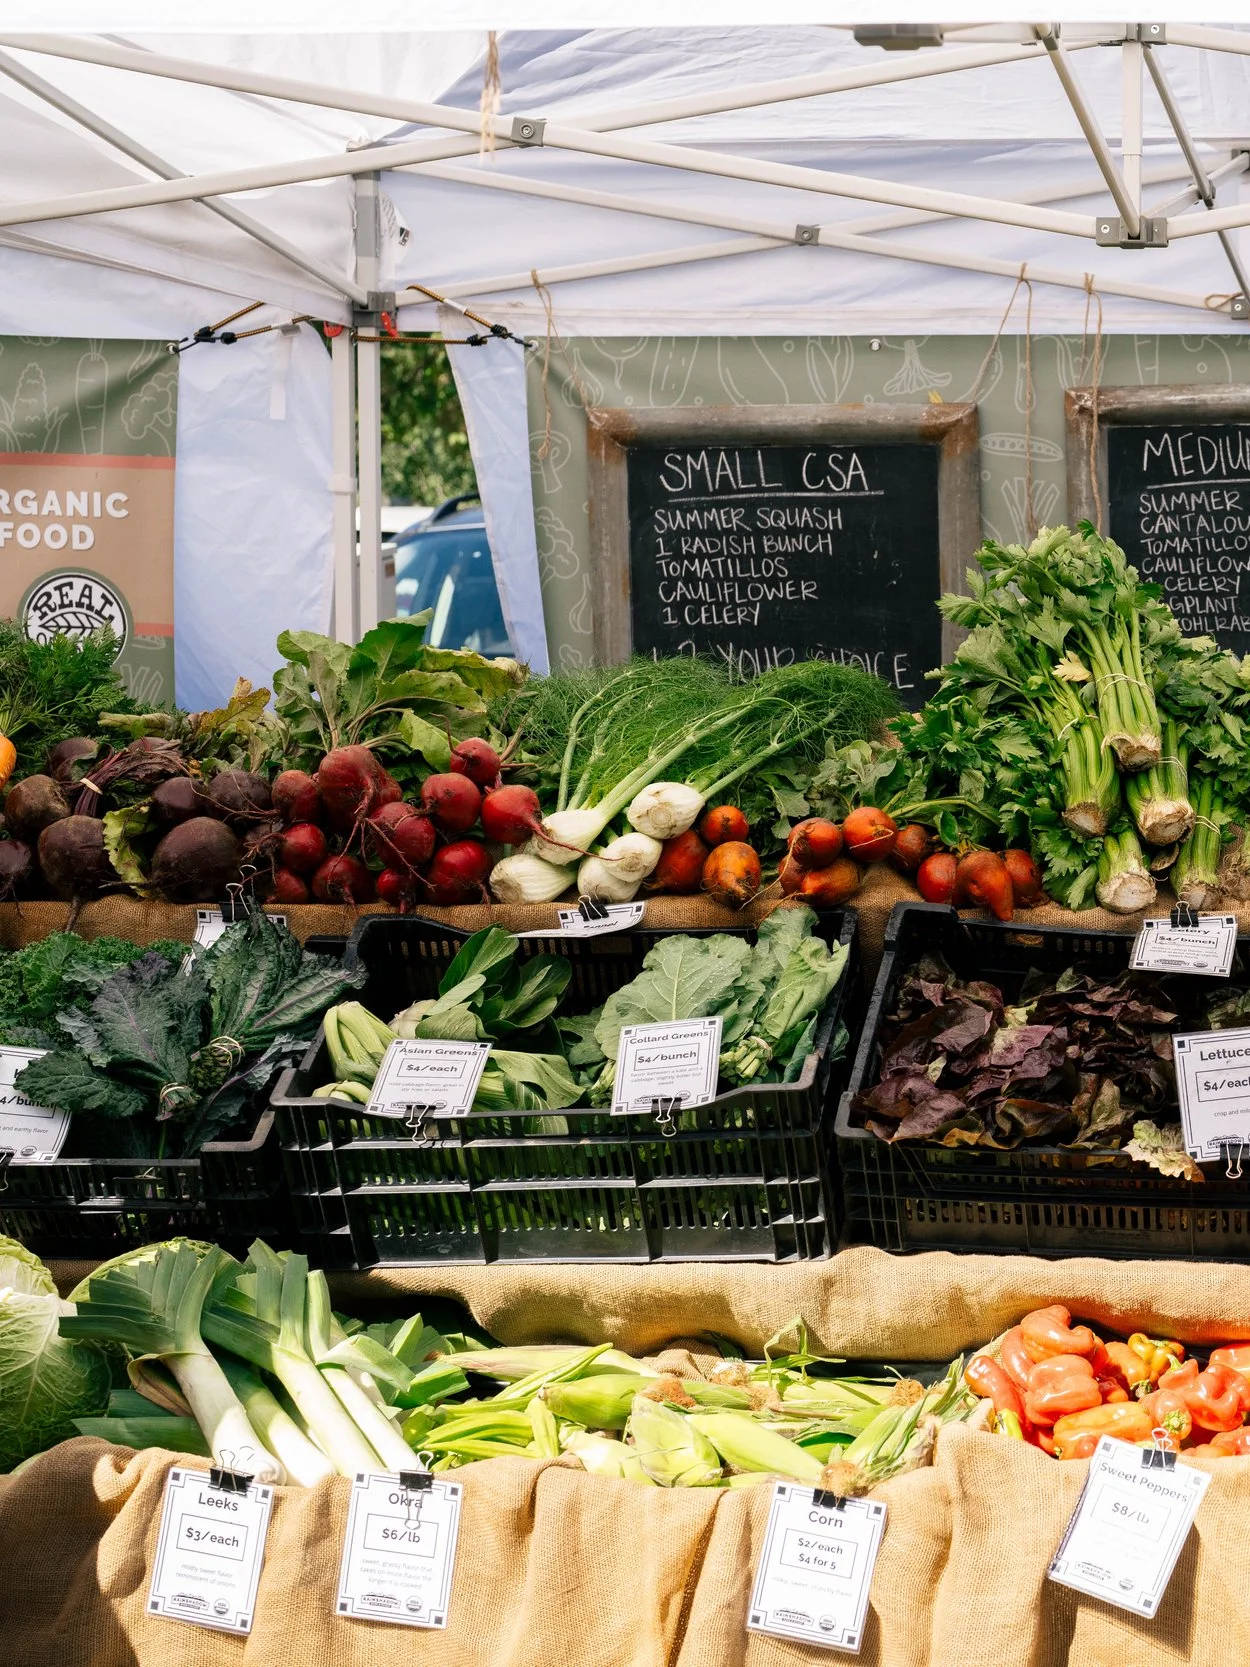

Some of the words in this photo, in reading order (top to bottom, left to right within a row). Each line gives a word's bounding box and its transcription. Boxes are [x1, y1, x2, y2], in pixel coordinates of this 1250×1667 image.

[660, 450, 783, 492] SMALL
[802, 452, 869, 491] CSA
[1140, 490, 1243, 514] SUMMER
[654, 506, 752, 534] SUMMER
[756, 506, 843, 531] SQUASH
[0, 521, 95, 551] FOOD
[656, 537, 673, 557] 1
[681, 535, 756, 556] RADISH
[763, 533, 833, 556] BUNCH
[658, 580, 819, 602] CAULIFLOWER
[1164, 575, 1241, 595] CELERY
[32, 581, 115, 622] REAL
[1158, 595, 1239, 614] GPLANT
[662, 606, 679, 625] 1
[684, 602, 760, 626] CELERY
[629, 1033, 669, 1045] Collard
[671, 1029, 709, 1040] Greens
[399, 1046, 433, 1056] Asian
[434, 1048, 479, 1057] Greens
[637, 1050, 697, 1064] $4/bunch
[406, 1064, 458, 1073] $4/each
[14, 1126, 32, 1134] earthy
[1098, 1461, 1137, 1485] Sweet
[1139, 1476, 1189, 1504] Peppers
[197, 1491, 239, 1512] Leeks
[388, 1492, 423, 1509] Okra
[808, 1510, 844, 1529] Corn
[1111, 1501, 1150, 1525] $8/lb
[185, 1526, 240, 1548] $3/each
[381, 1527, 421, 1544] $6/lb
[797, 1536, 844, 1556] $2/each
[798, 1552, 811, 1565] $4
[813, 1556, 829, 1567] for
[830, 1560, 837, 1571] 5
